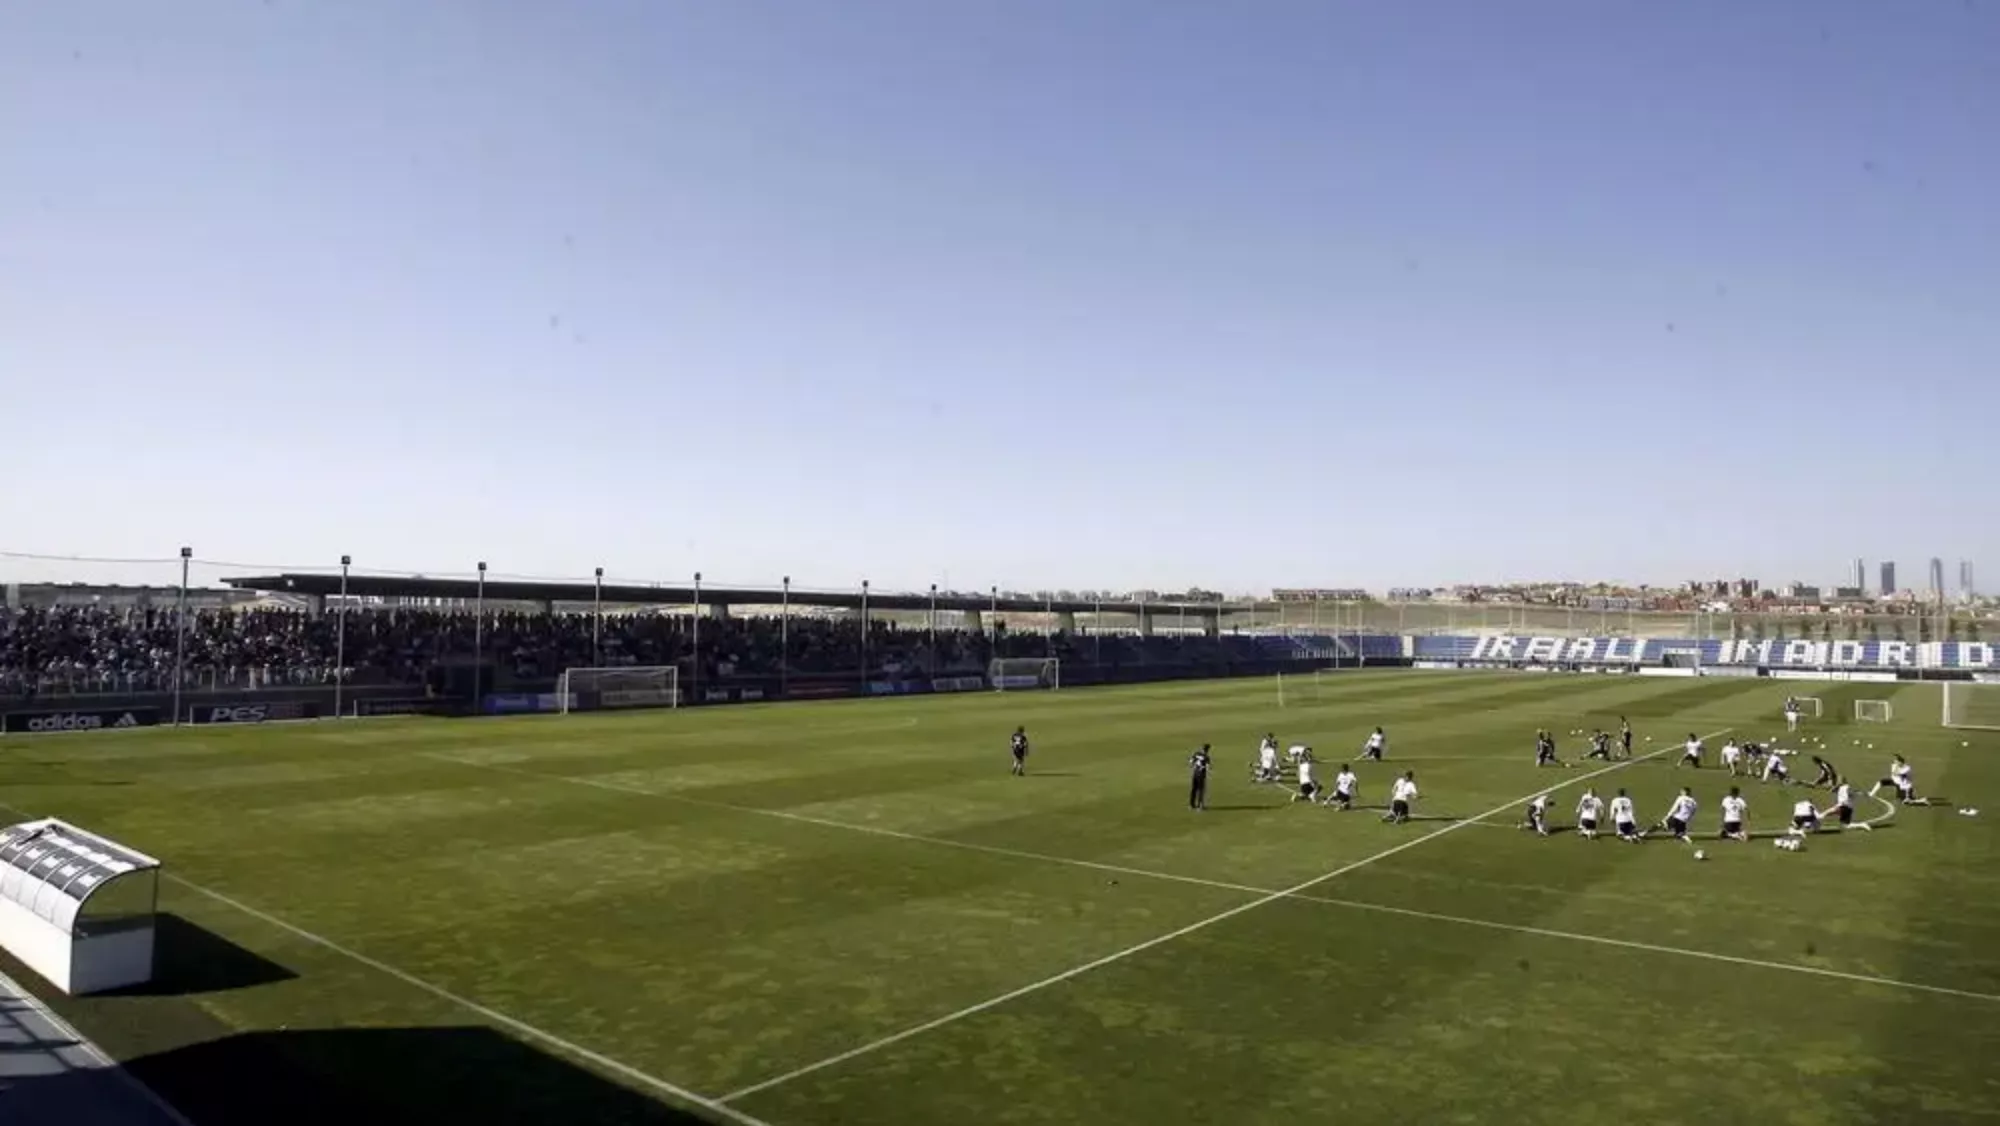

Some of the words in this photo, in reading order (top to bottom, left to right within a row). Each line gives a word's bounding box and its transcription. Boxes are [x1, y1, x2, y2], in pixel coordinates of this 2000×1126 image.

[1486, 637, 1633, 660] REAL
[1735, 639, 1993, 666] MADRID
[28, 711, 101, 730] adidas
[210, 705, 267, 722] PES
